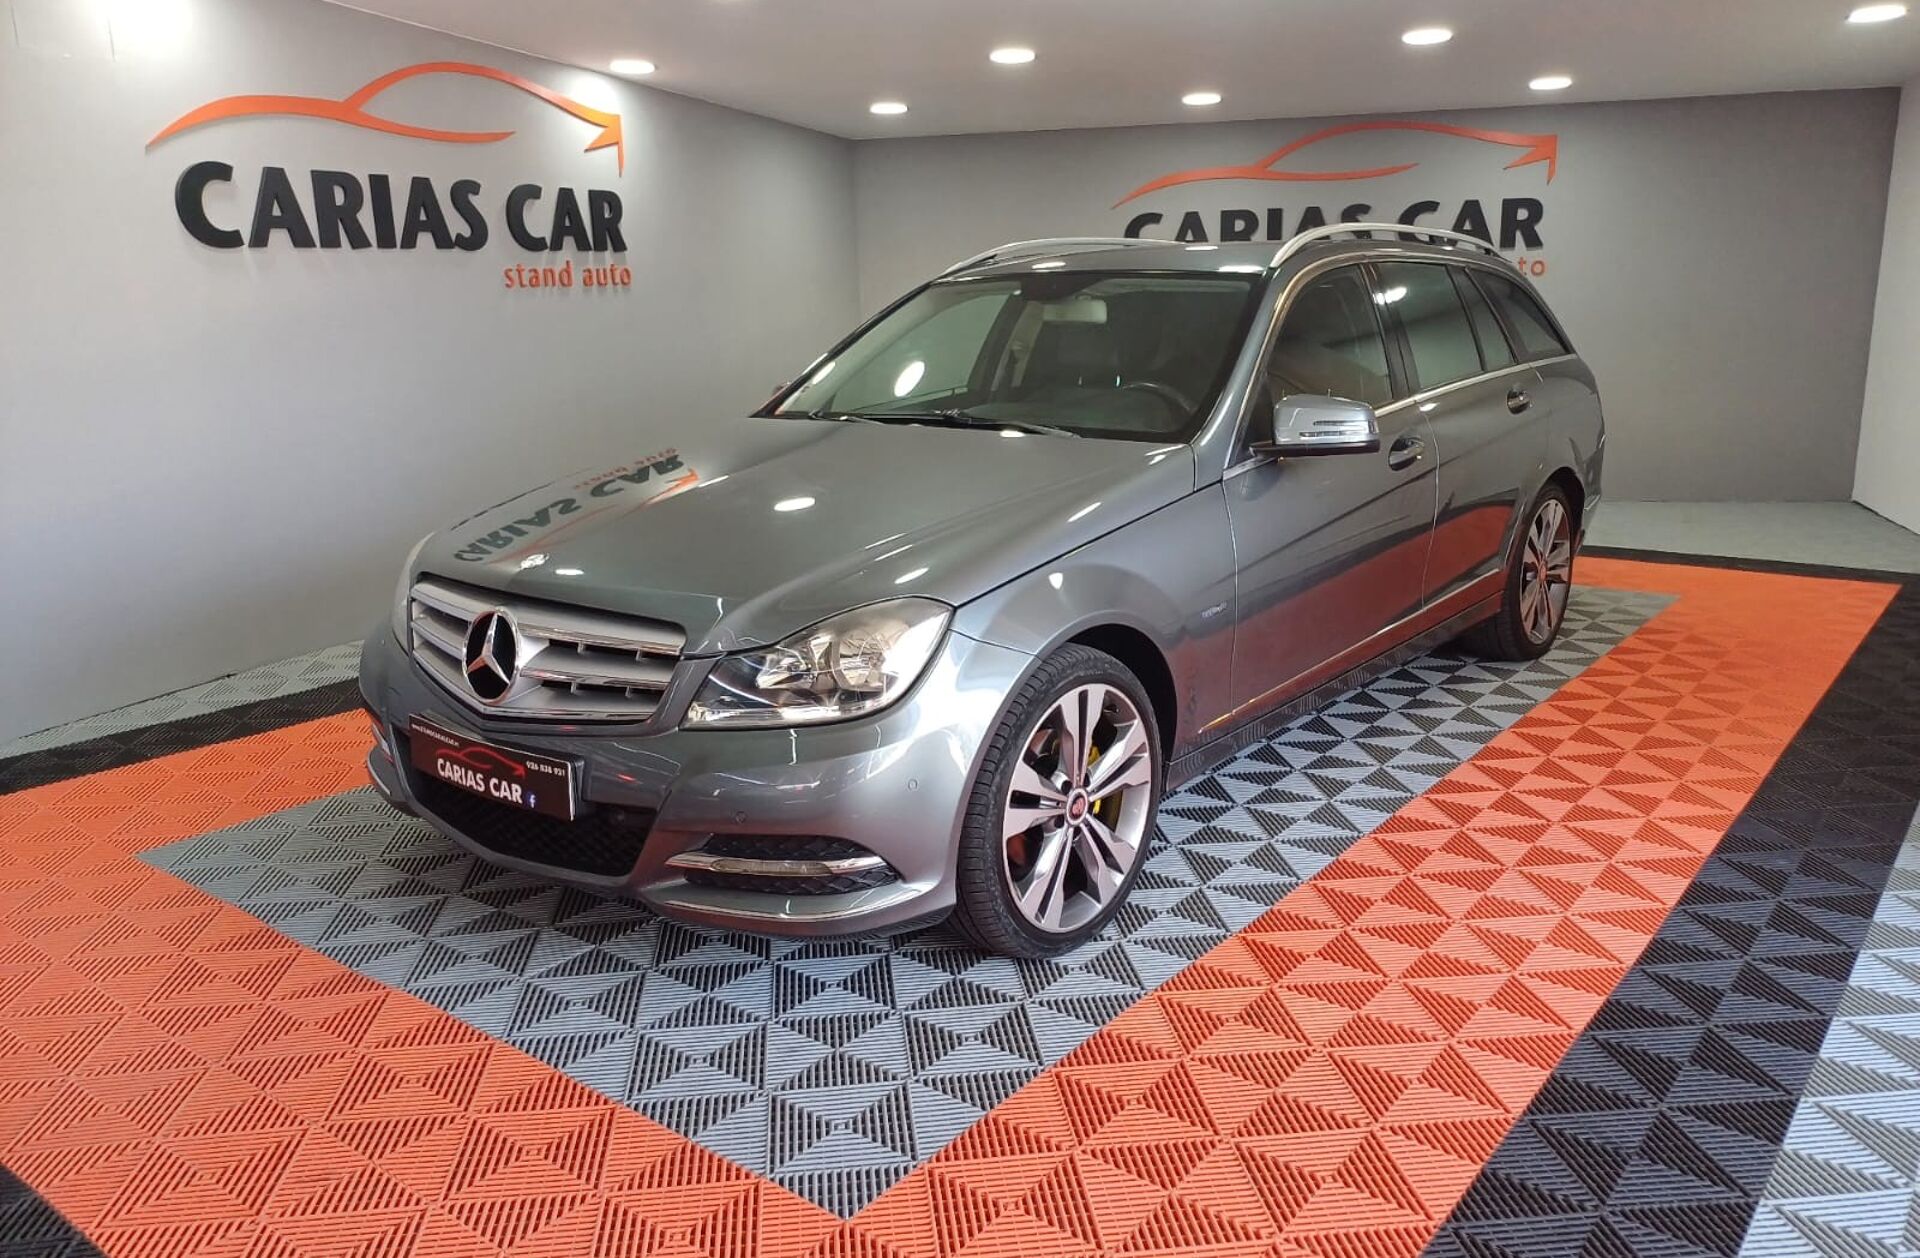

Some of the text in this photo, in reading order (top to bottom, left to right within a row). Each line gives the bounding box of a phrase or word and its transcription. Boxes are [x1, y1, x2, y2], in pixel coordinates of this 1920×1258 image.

[175, 160, 628, 252] CARIAS CAR
[1398, 197, 1543, 249] CAR
[504, 260, 632, 288] stand auto
[437, 757, 522, 804] CARIAS CAR
